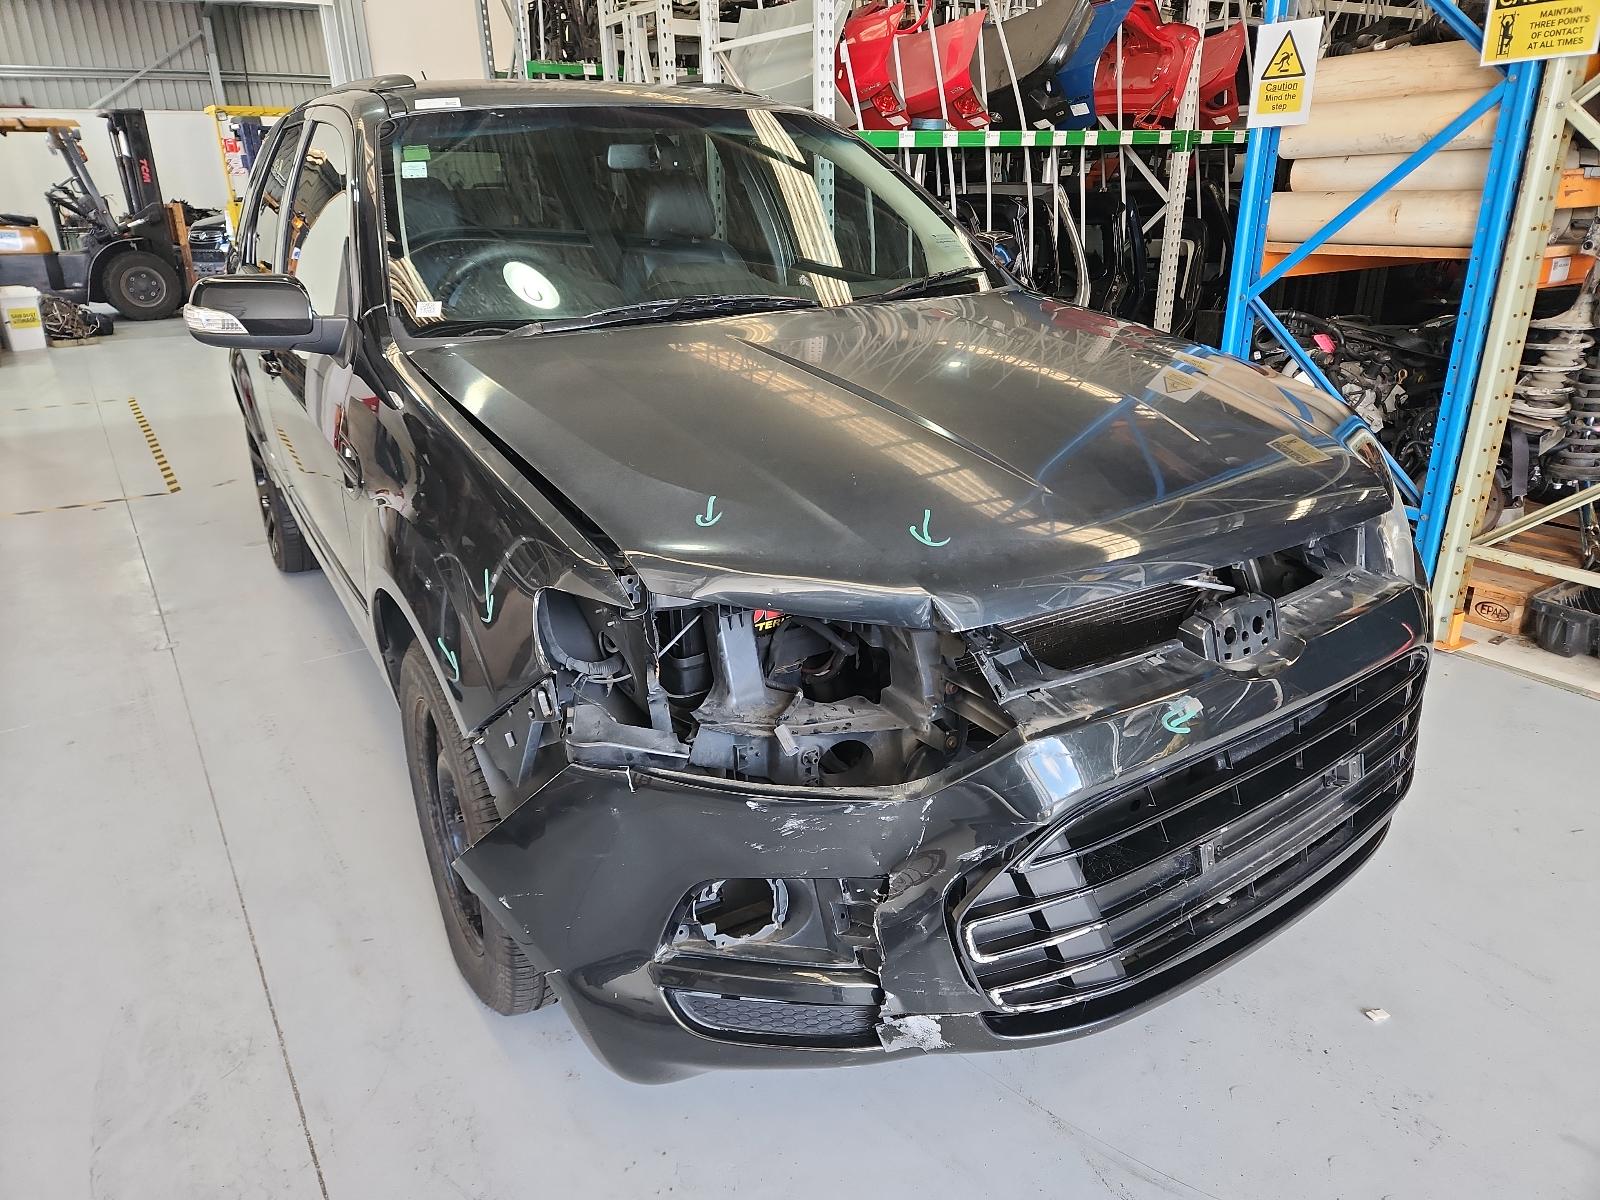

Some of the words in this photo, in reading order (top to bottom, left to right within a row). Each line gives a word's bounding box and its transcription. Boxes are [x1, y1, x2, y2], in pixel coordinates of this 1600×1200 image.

[1540, 6, 1583, 18] MAINTAIN
[1530, 20, 1556, 29] THREE
[1557, 15, 1591, 26] POINTS
[1531, 31, 1542, 39] OF
[1544, 26, 1584, 38] CONTACT
[1527, 42, 1538, 50] AT
[1540, 40, 1554, 48] ALL
[1557, 37, 1584, 47] TIMES
[1265, 82, 1298, 91] Caution
[1284, 92, 1297, 100] the
[1271, 103, 1287, 111] step
[139, 158, 151, 183] TCM
